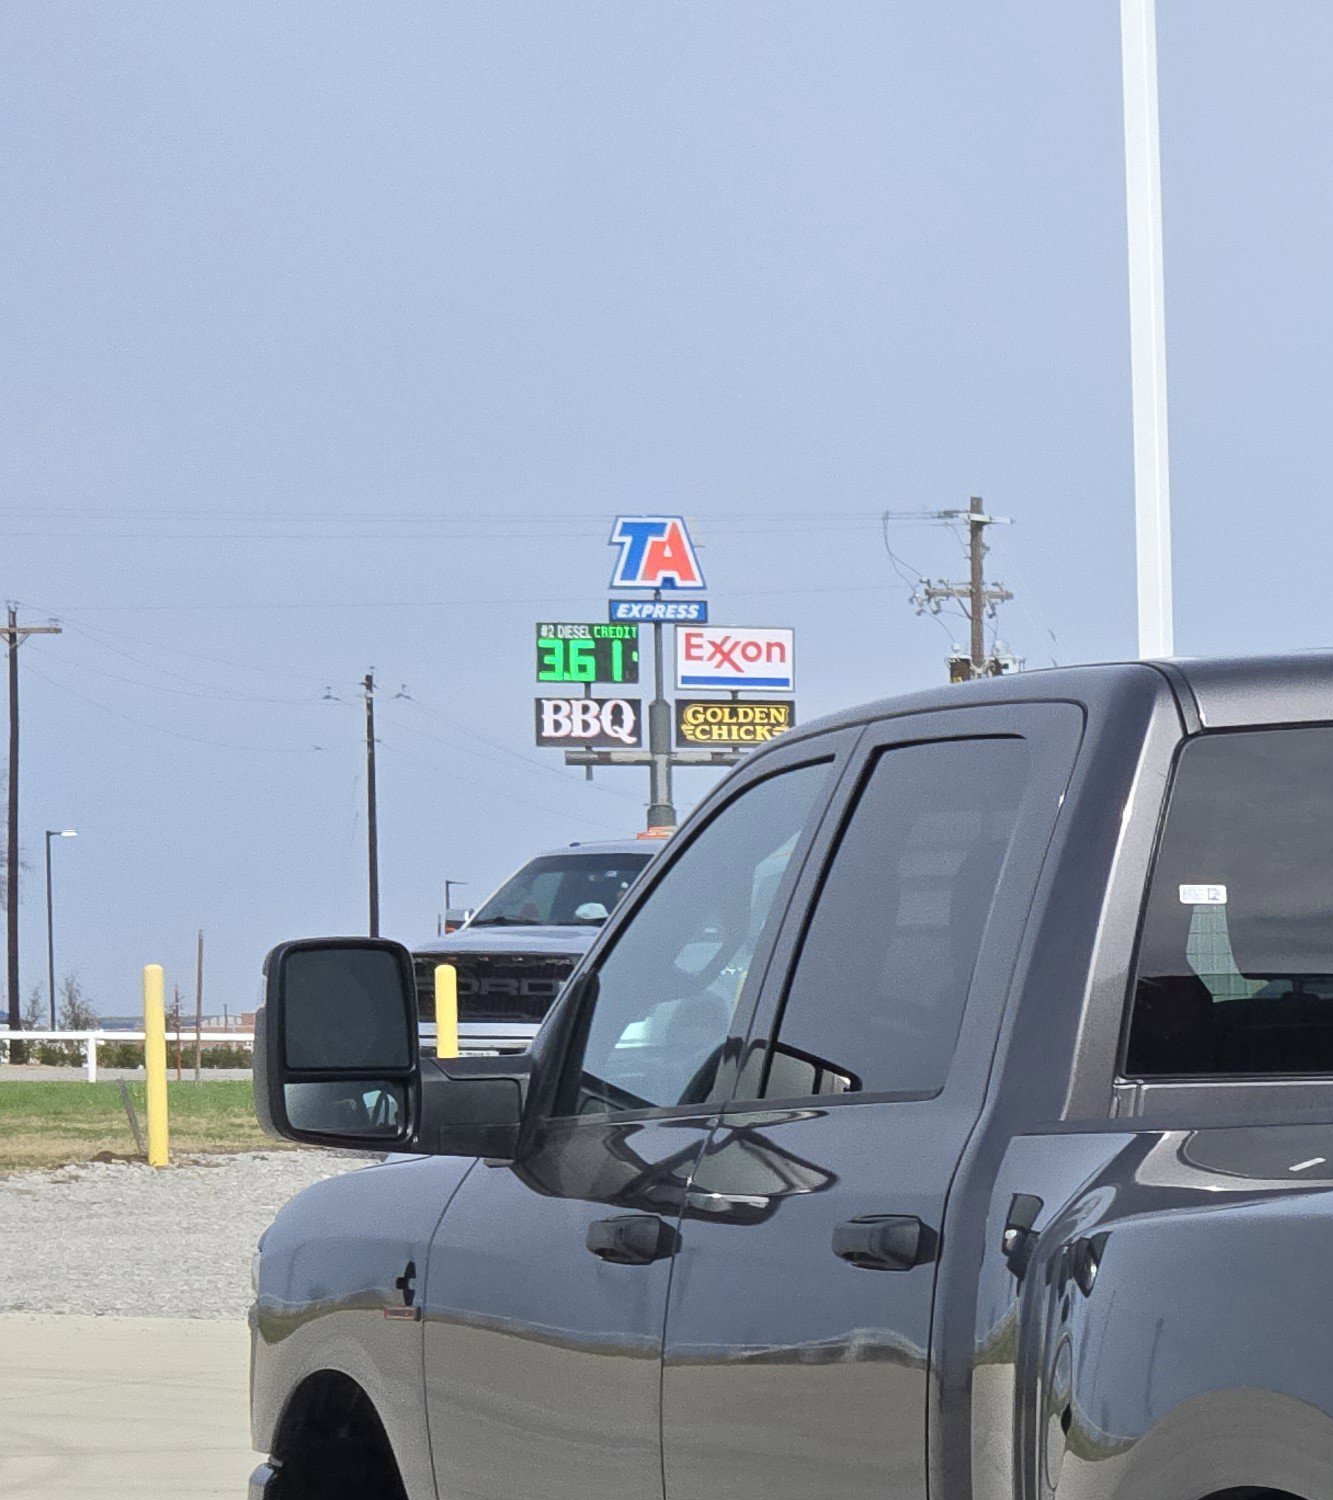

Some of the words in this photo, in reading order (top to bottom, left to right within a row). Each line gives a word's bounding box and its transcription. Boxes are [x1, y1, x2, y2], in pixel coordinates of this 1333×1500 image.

[616, 521, 698, 582] TA
[617, 603, 699, 620] EXPRESS
[557, 625, 592, 638] DIESEL
[684, 633, 786, 672] Exxon
[541, 699, 638, 744] BBQ
[686, 707, 785, 725] GOLDEN
[695, 725, 773, 741] CHICK
